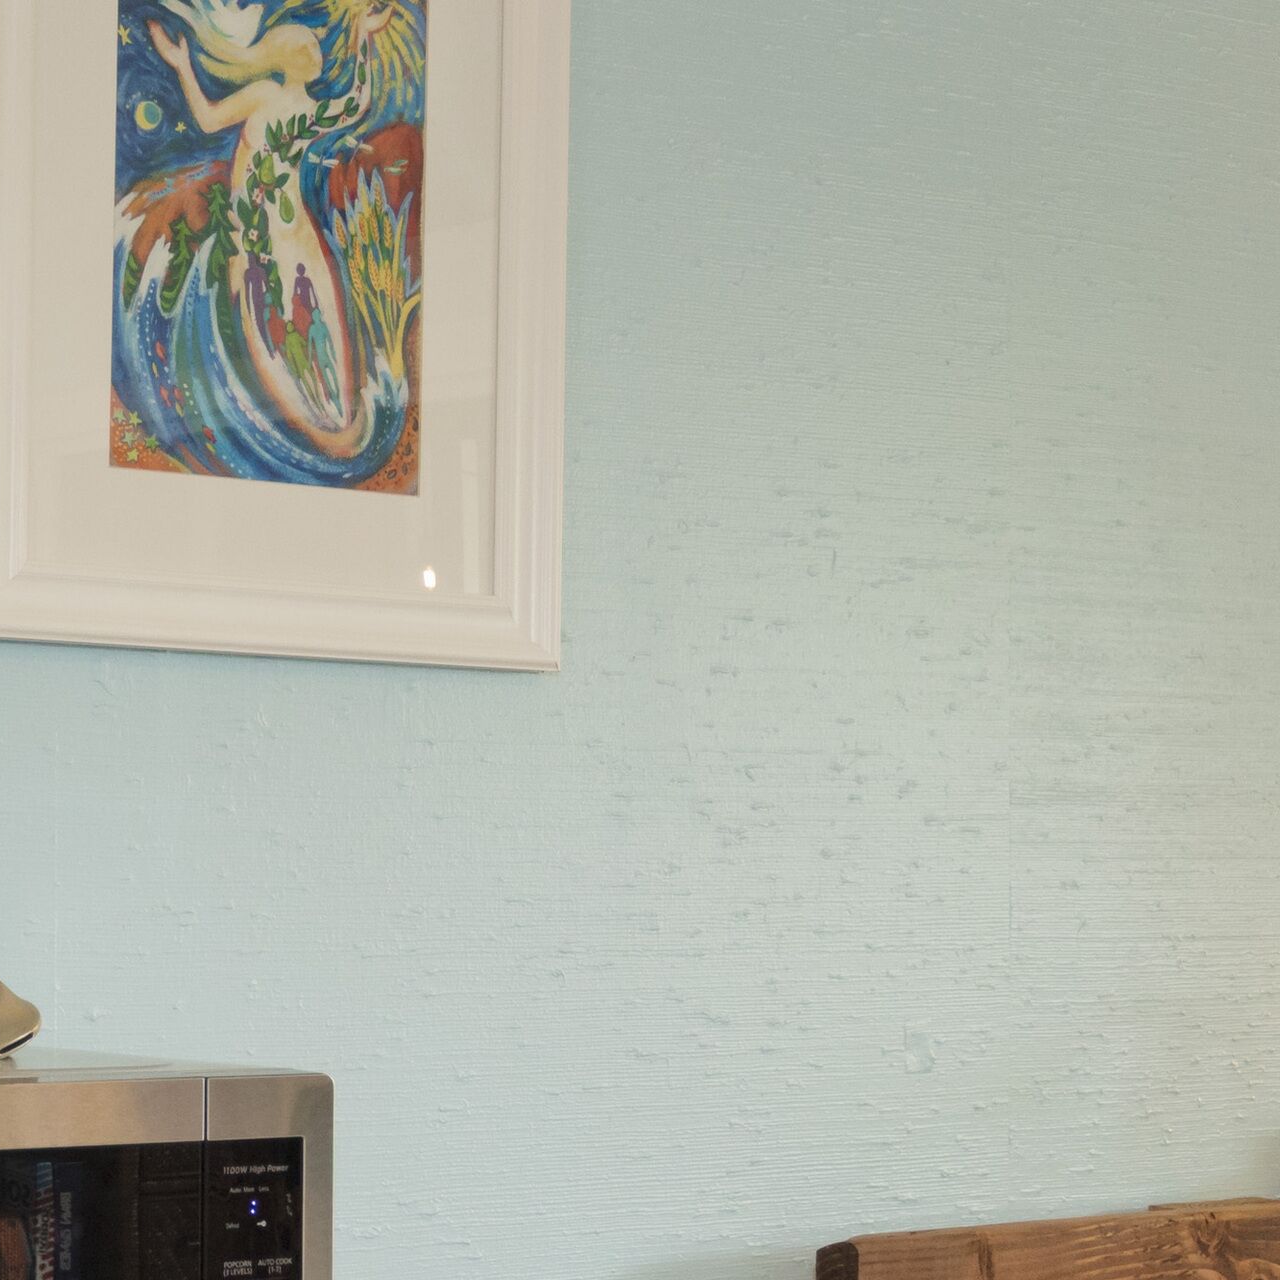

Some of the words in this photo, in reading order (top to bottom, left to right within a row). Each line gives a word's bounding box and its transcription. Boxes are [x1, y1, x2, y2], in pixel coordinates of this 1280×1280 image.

[223, 1166, 247, 1175] 1100W
[249, 1165, 266, 1174] High
[267, 1164, 288, 1172] Power
[258, 1258, 275, 1266] AUTO
